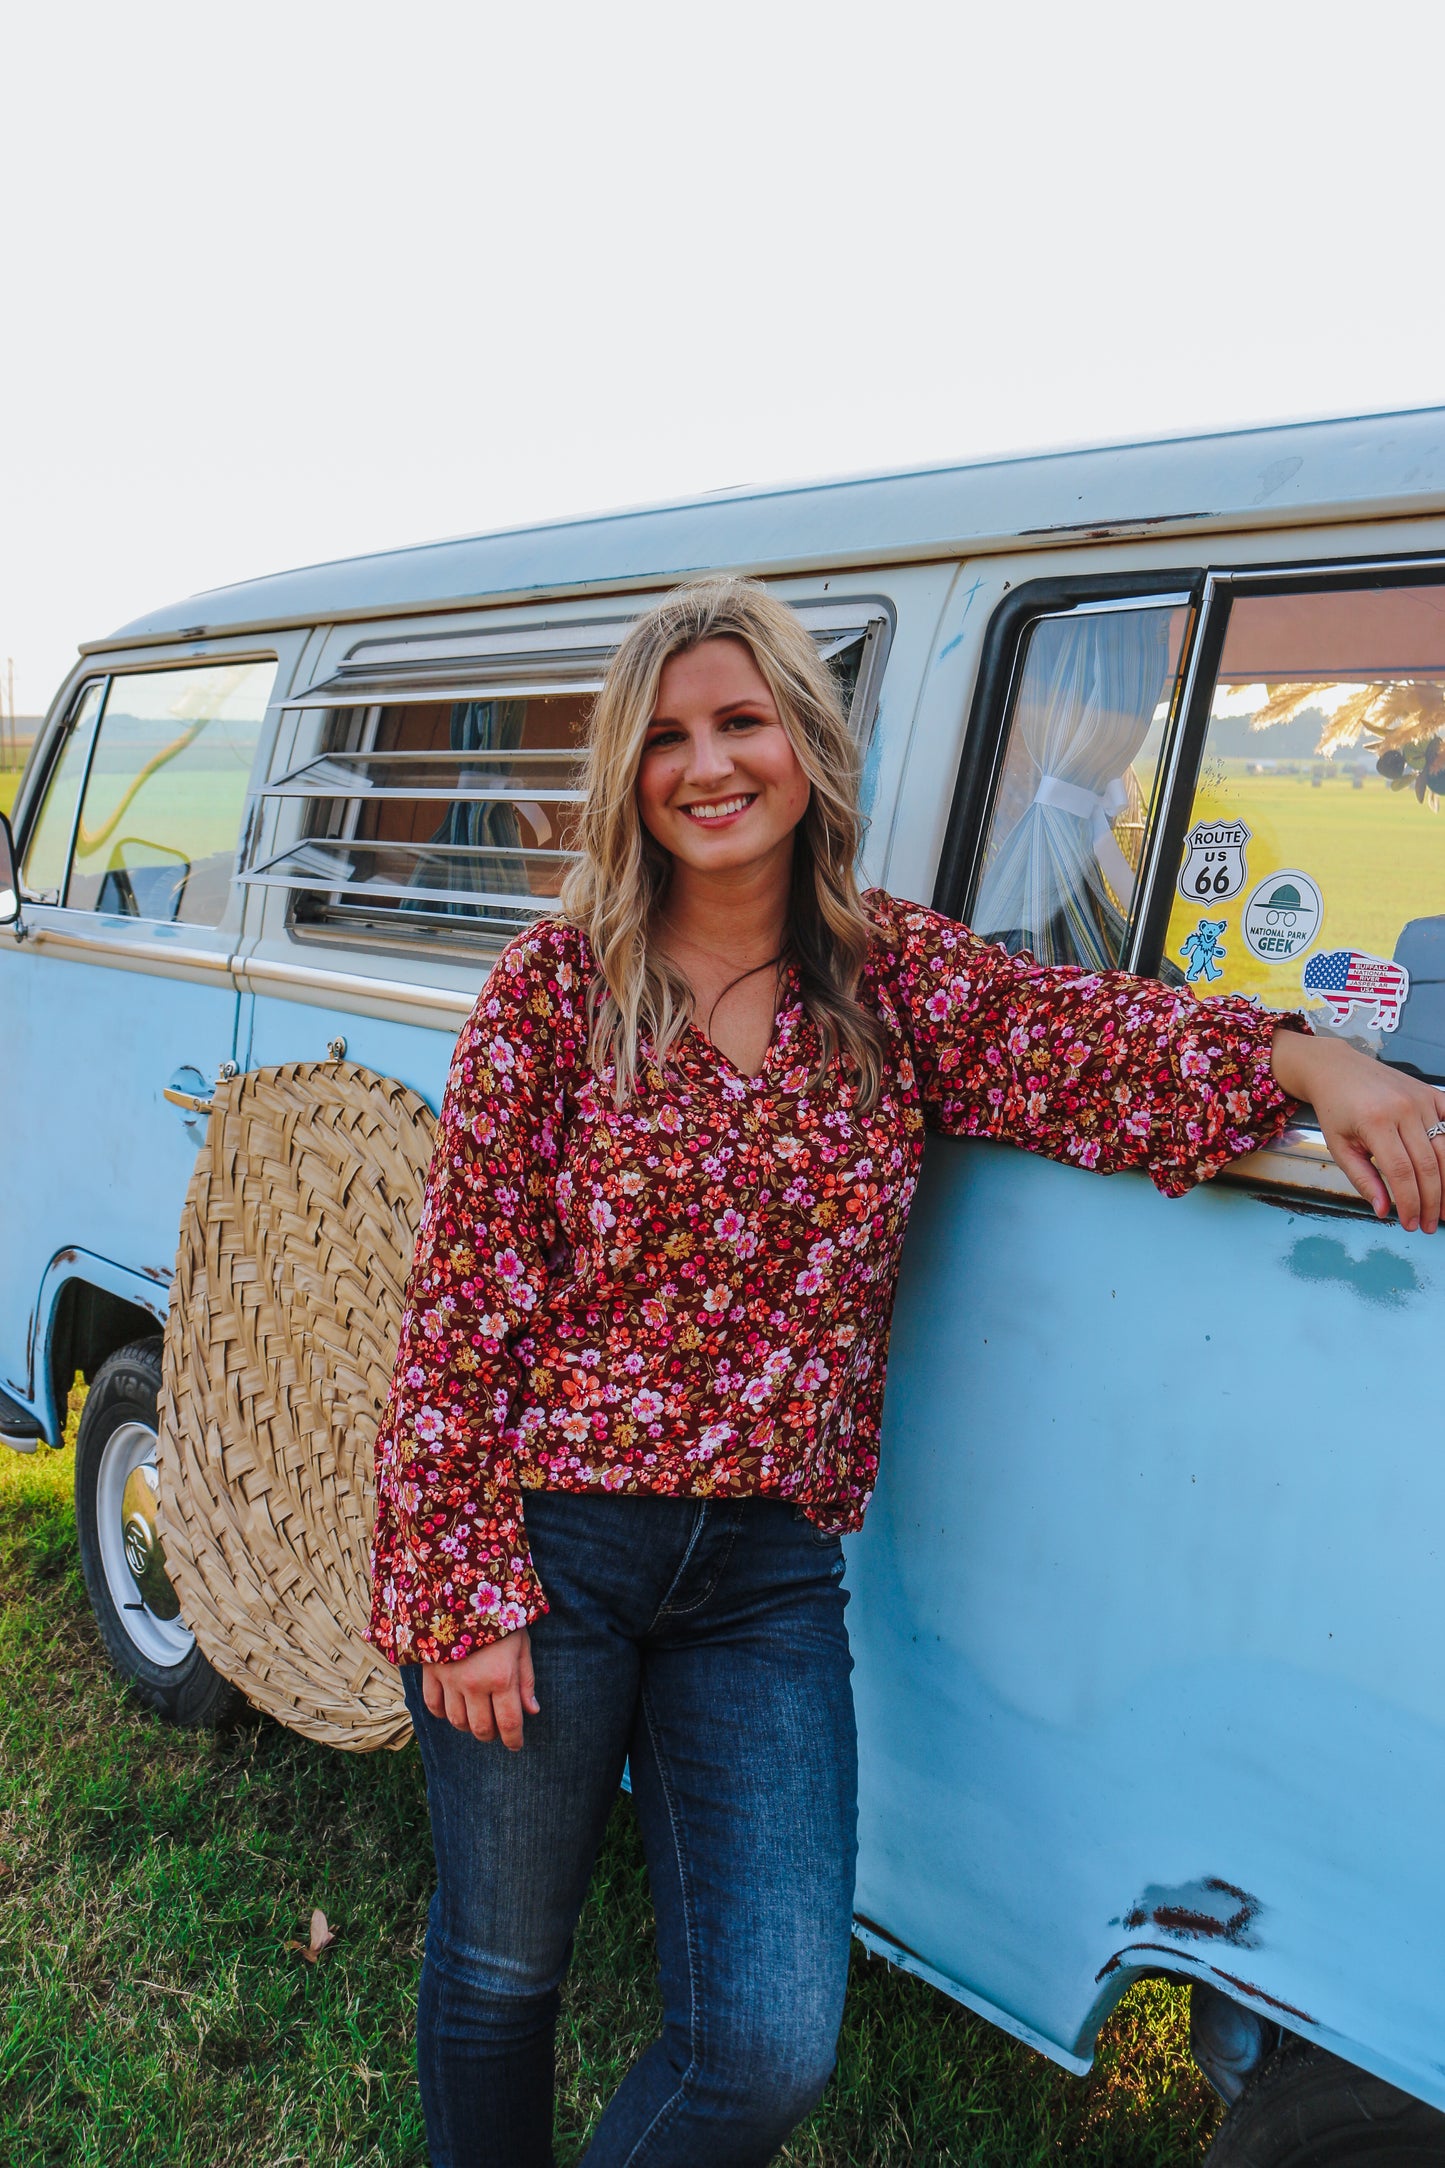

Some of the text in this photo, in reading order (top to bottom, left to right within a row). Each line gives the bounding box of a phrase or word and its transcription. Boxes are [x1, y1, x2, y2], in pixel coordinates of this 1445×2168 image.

[1195, 831, 1241, 845] ROUTE
[1205, 851, 1226, 862] US
[1195, 865, 1229, 894] 66
[1250, 927, 1307, 939] NATIONAL PARK
[1258, 937, 1294, 953] GEEK
